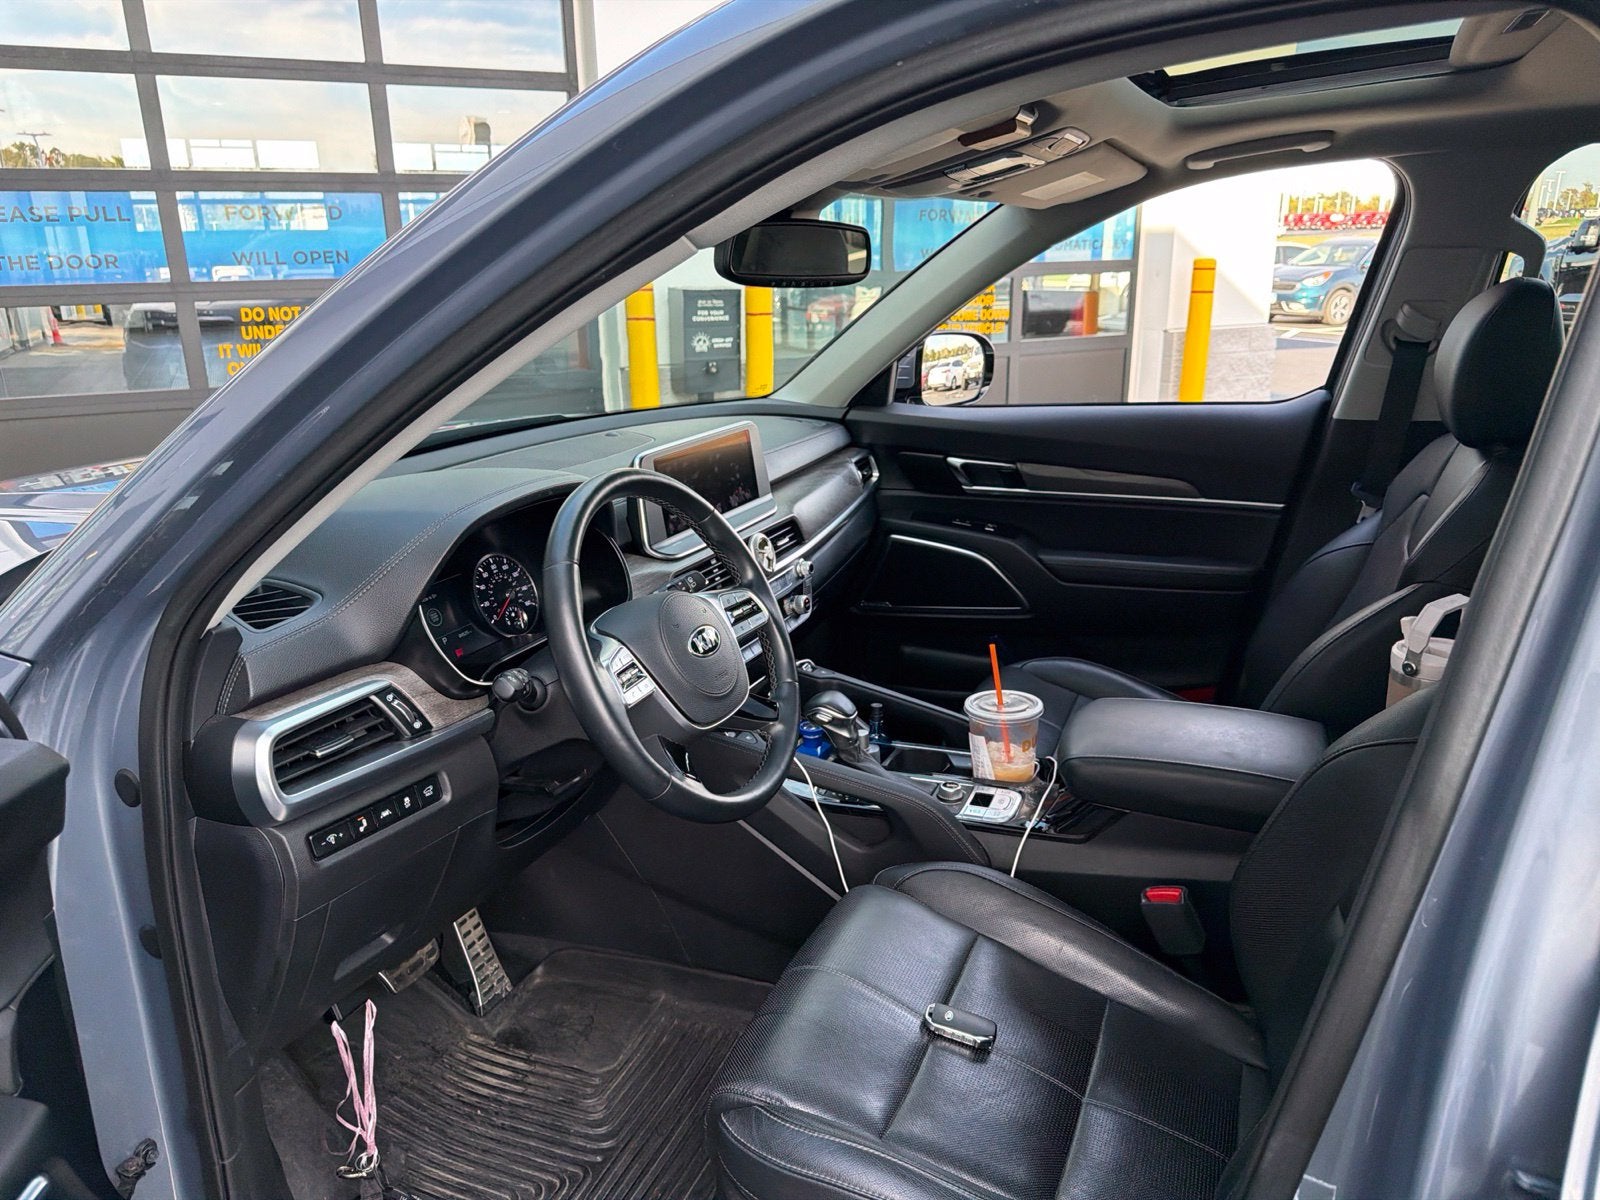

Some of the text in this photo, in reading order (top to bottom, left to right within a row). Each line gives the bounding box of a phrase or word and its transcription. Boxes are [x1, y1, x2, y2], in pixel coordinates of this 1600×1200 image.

[67, 205, 131, 222] PULL
[49, 254, 119, 270] DOOR
[232, 249, 349, 266] WILL OPEN
[240, 306, 265, 322] DO
[268, 305, 302, 321] NOT
[240, 324, 284, 341] UNDE
[217, 343, 233, 359] IT
